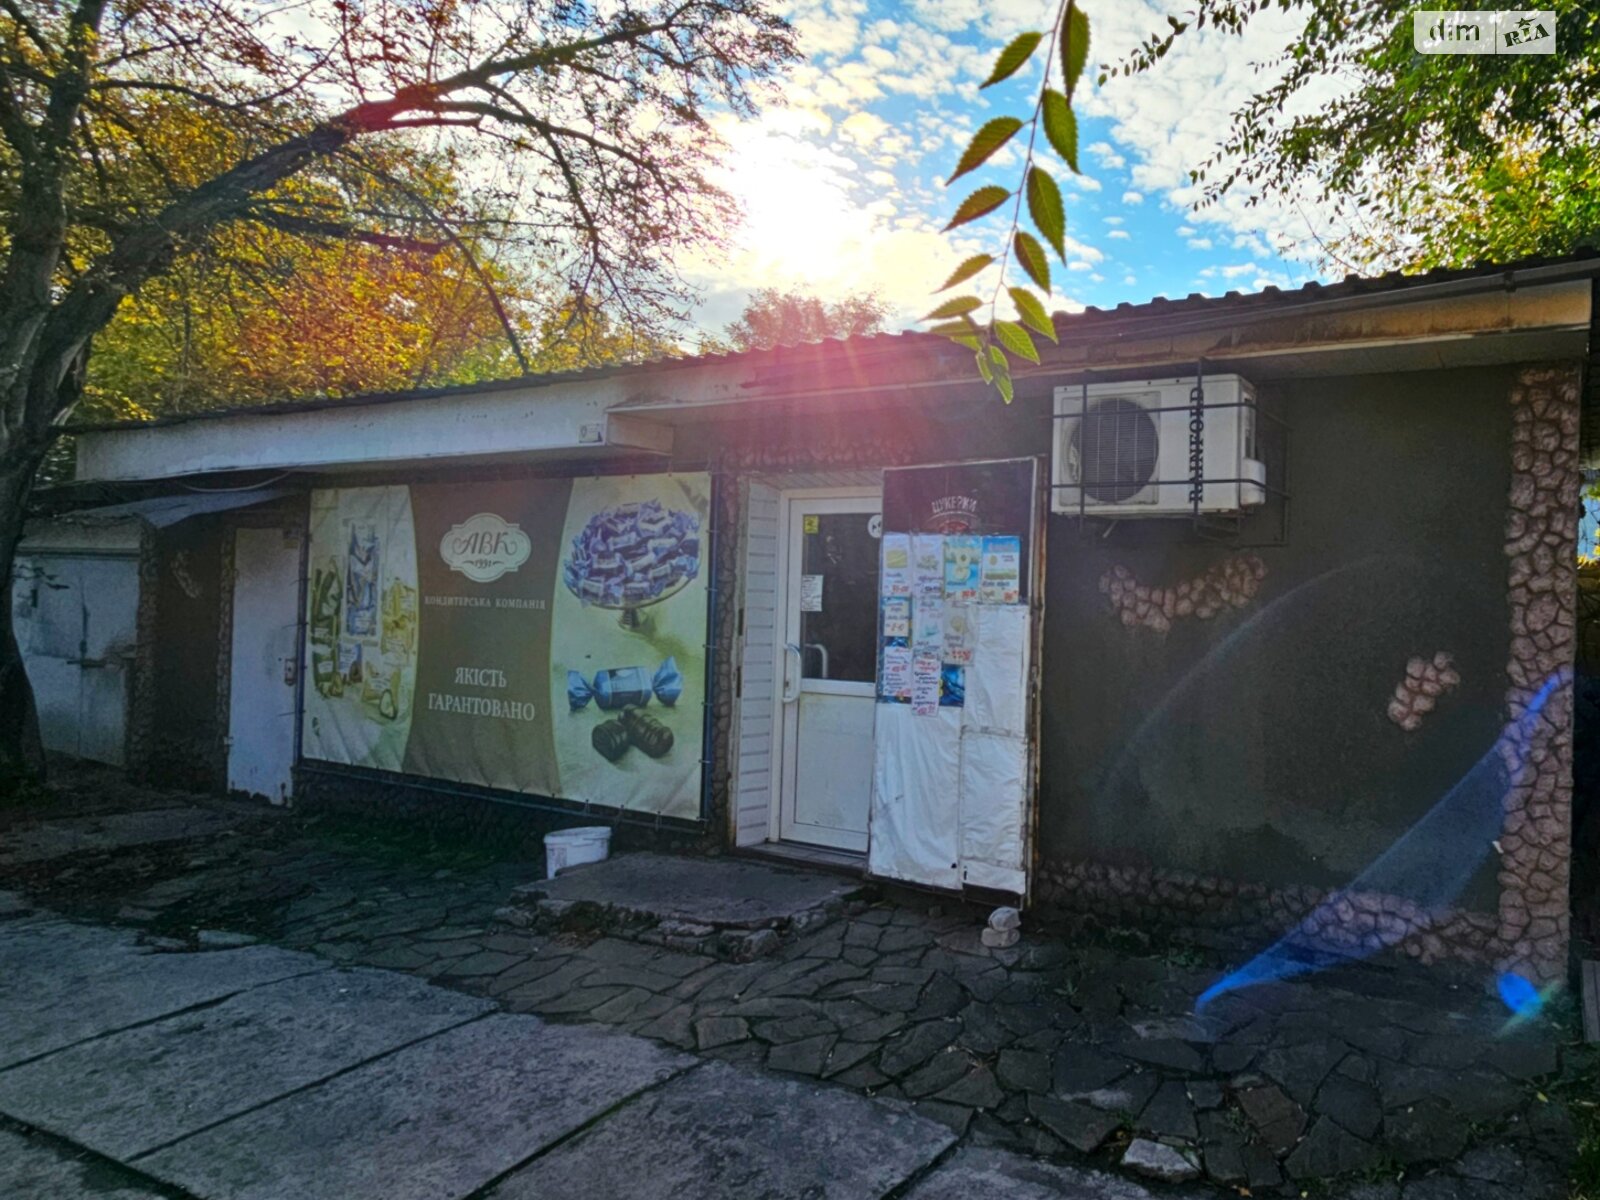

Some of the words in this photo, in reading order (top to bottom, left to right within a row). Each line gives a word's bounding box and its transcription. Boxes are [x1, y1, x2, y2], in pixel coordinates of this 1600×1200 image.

[1188, 386, 1205, 503] RAINFORD
[452, 531, 518, 556] АВК
[424, 595, 491, 608] КОНДИТЕРСЬКА
[495, 597, 546, 610] КОМПАНІЯ
[455, 666, 507, 688] ЯКІСТЬ
[429, 693, 535, 722] ГАРАНТОВАНО
